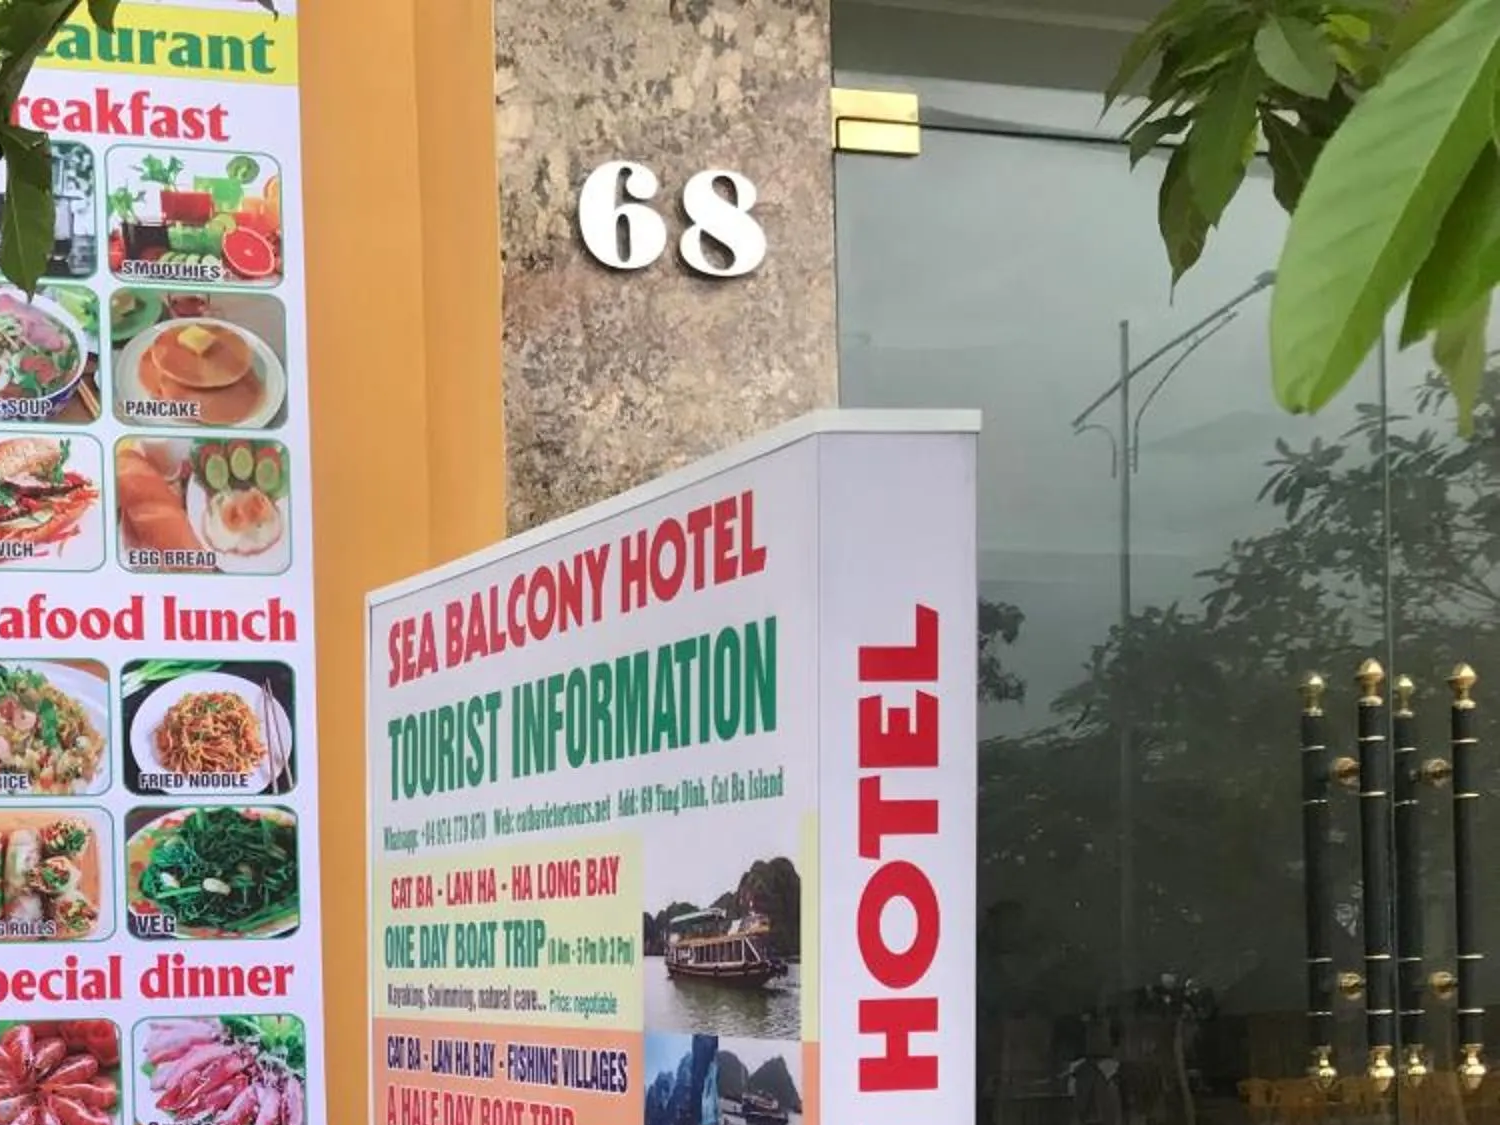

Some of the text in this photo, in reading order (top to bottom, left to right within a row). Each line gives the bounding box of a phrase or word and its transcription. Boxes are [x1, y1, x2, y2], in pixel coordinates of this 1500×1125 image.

[579, 160, 768, 277] 68
[122, 260, 221, 278] SMOOTHIES
[7, 399, 51, 416] SOUP
[126, 401, 199, 417] PANCAKE
[129, 551, 216, 566] EGG BREAD
[388, 490, 767, 688] SEA BALCONY HOTEL
[162, 596, 298, 642] lunch
[388, 616, 777, 800] TOURIST INFORMATION
[140, 773, 248, 789] FRIED NOODLE
[712, 774, 729, 804] Cat
[732, 772, 745, 803] Ba
[749, 766, 783, 800] Island
[857, 603, 941, 1092] HOTEL
[447, 856, 620, 906] LAN HA HA LONG BAY
[10, 922, 56, 935] ROLLS
[137, 916, 175, 933] VEG
[385, 925, 415, 968] ONE
[420, 924, 450, 968] DAY
[455, 922, 497, 968] BOAT
[504, 920, 546, 968] TRIP
[140, 954, 295, 998] dinner
[431, 1040, 628, 1093] LAN HA BAY FISHING VILLAGES
